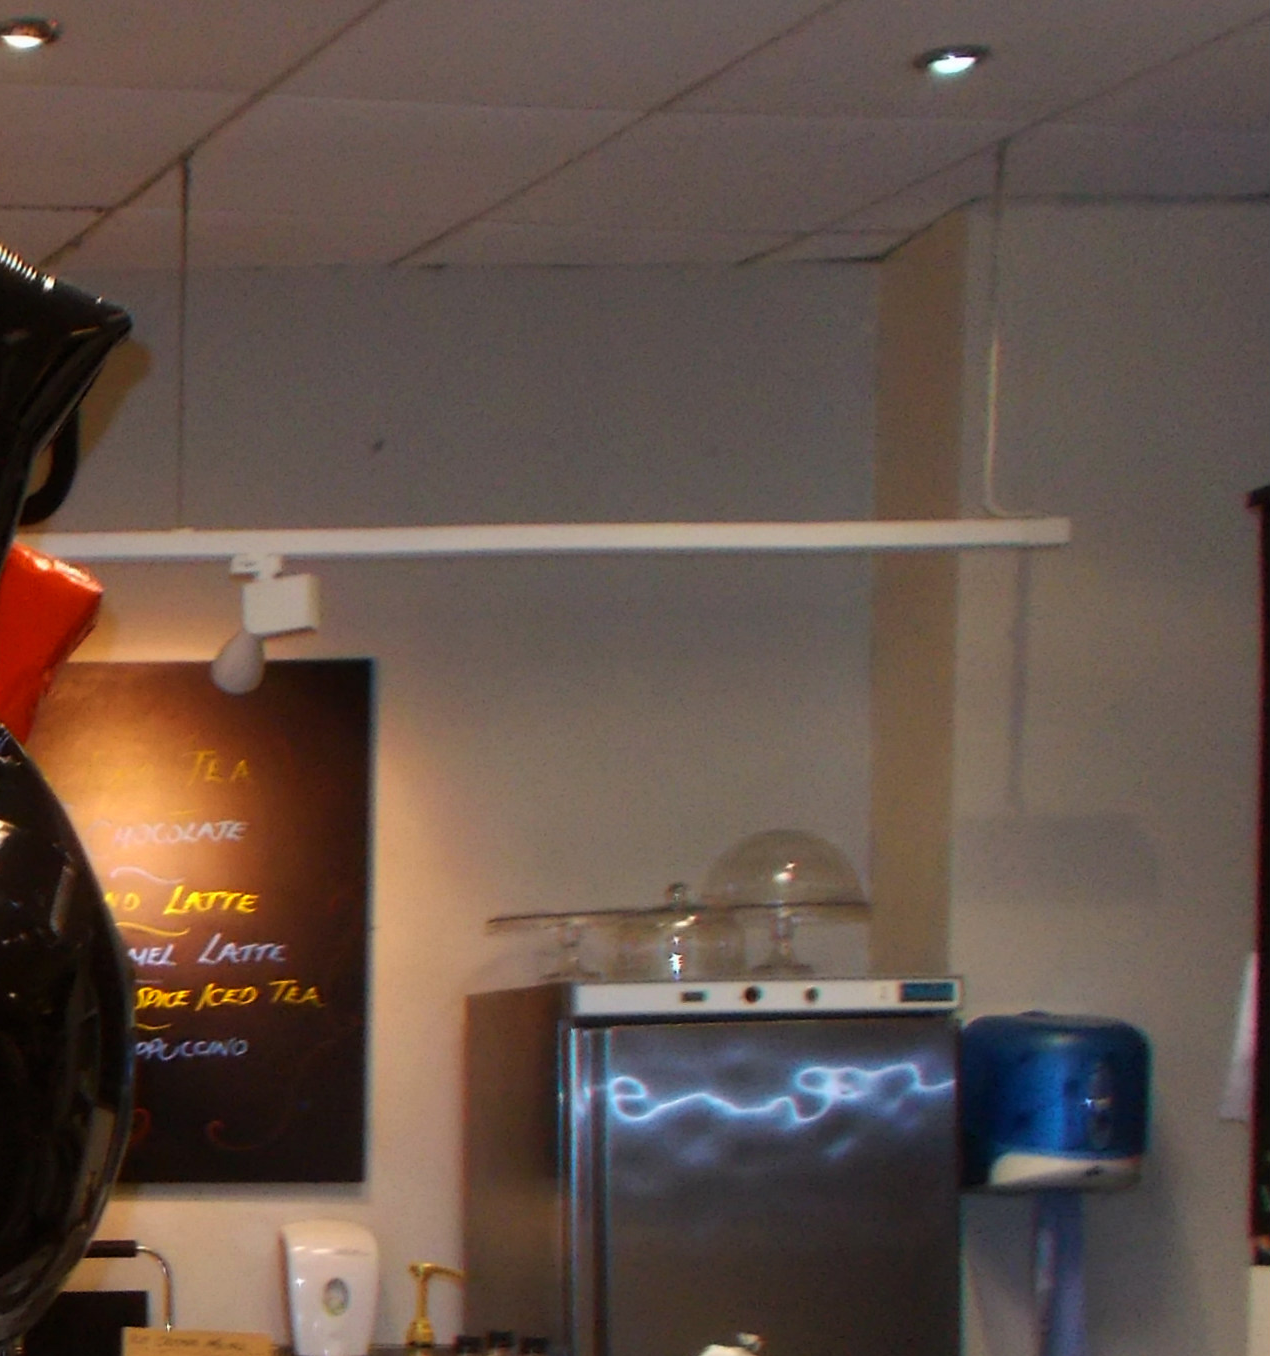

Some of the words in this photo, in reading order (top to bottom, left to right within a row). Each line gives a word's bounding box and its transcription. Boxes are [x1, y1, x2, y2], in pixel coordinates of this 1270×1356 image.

[162, 885, 260, 915] LATTE
[197, 933, 289, 965] LATTE
[195, 982, 259, 1012] ICED
[267, 979, 326, 1009] TEA
